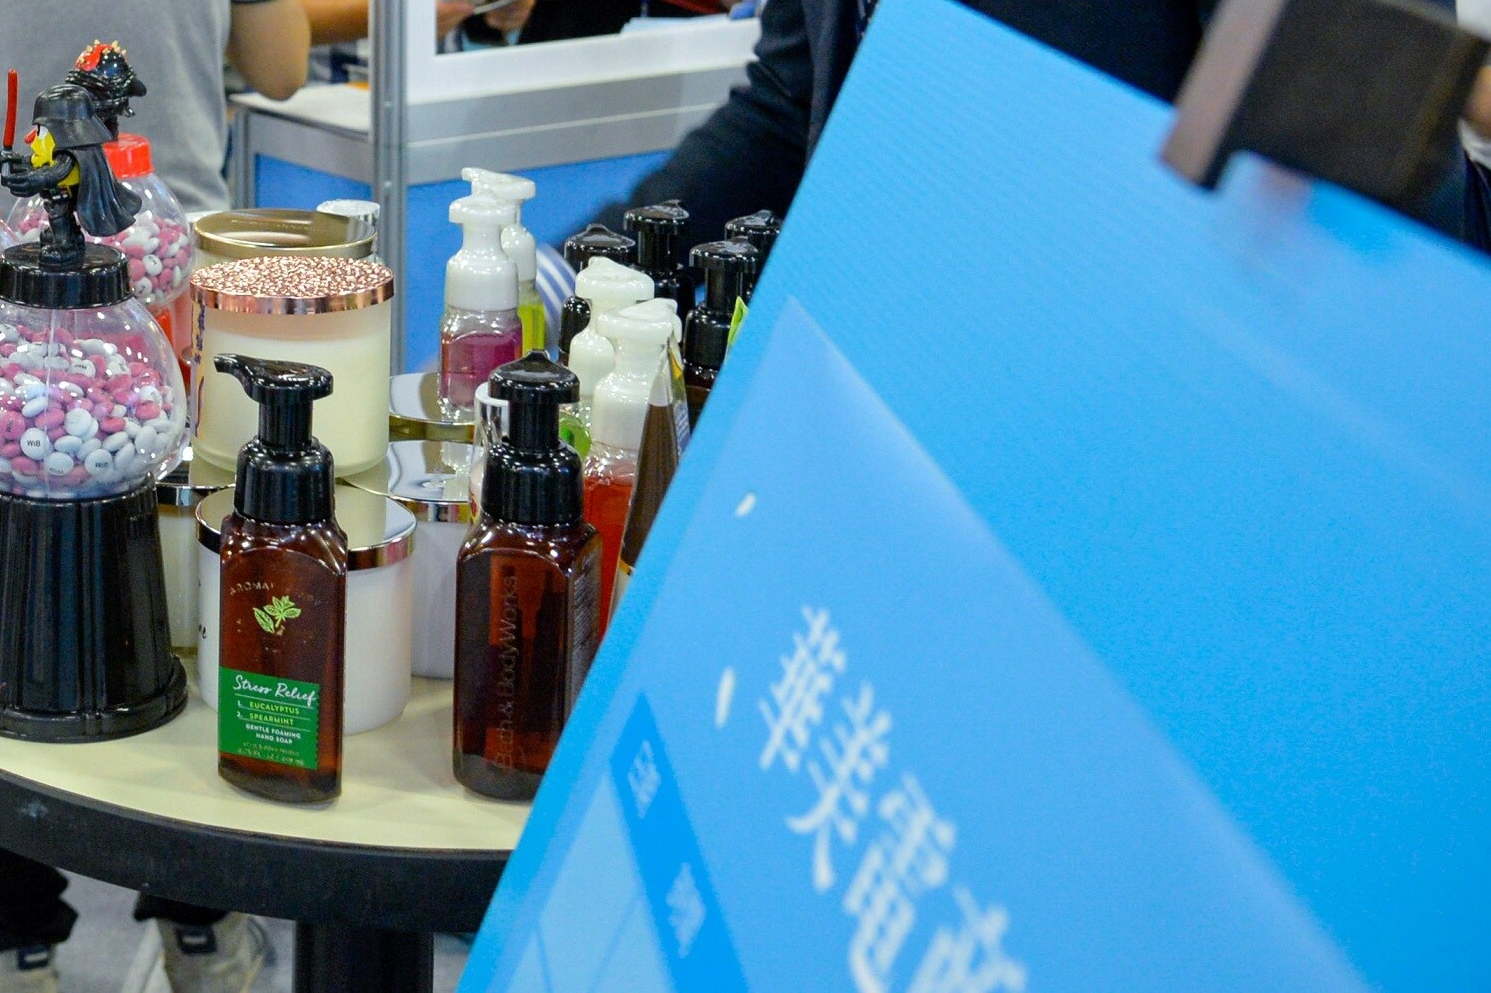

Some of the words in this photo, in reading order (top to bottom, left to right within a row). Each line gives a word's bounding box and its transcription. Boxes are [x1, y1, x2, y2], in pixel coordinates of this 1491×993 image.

[232, 674, 272, 695] Stress
[274, 681, 318, 707] Relief
[249, 700, 300, 716] EUCALYPTUS
[249, 711, 294, 726] SPEARMINT
[245, 723, 270, 734] GENTLE
[271, 727, 301, 739] FOAMING
[255, 732, 275, 743] HAND
[276, 736, 293, 745] SOAP
